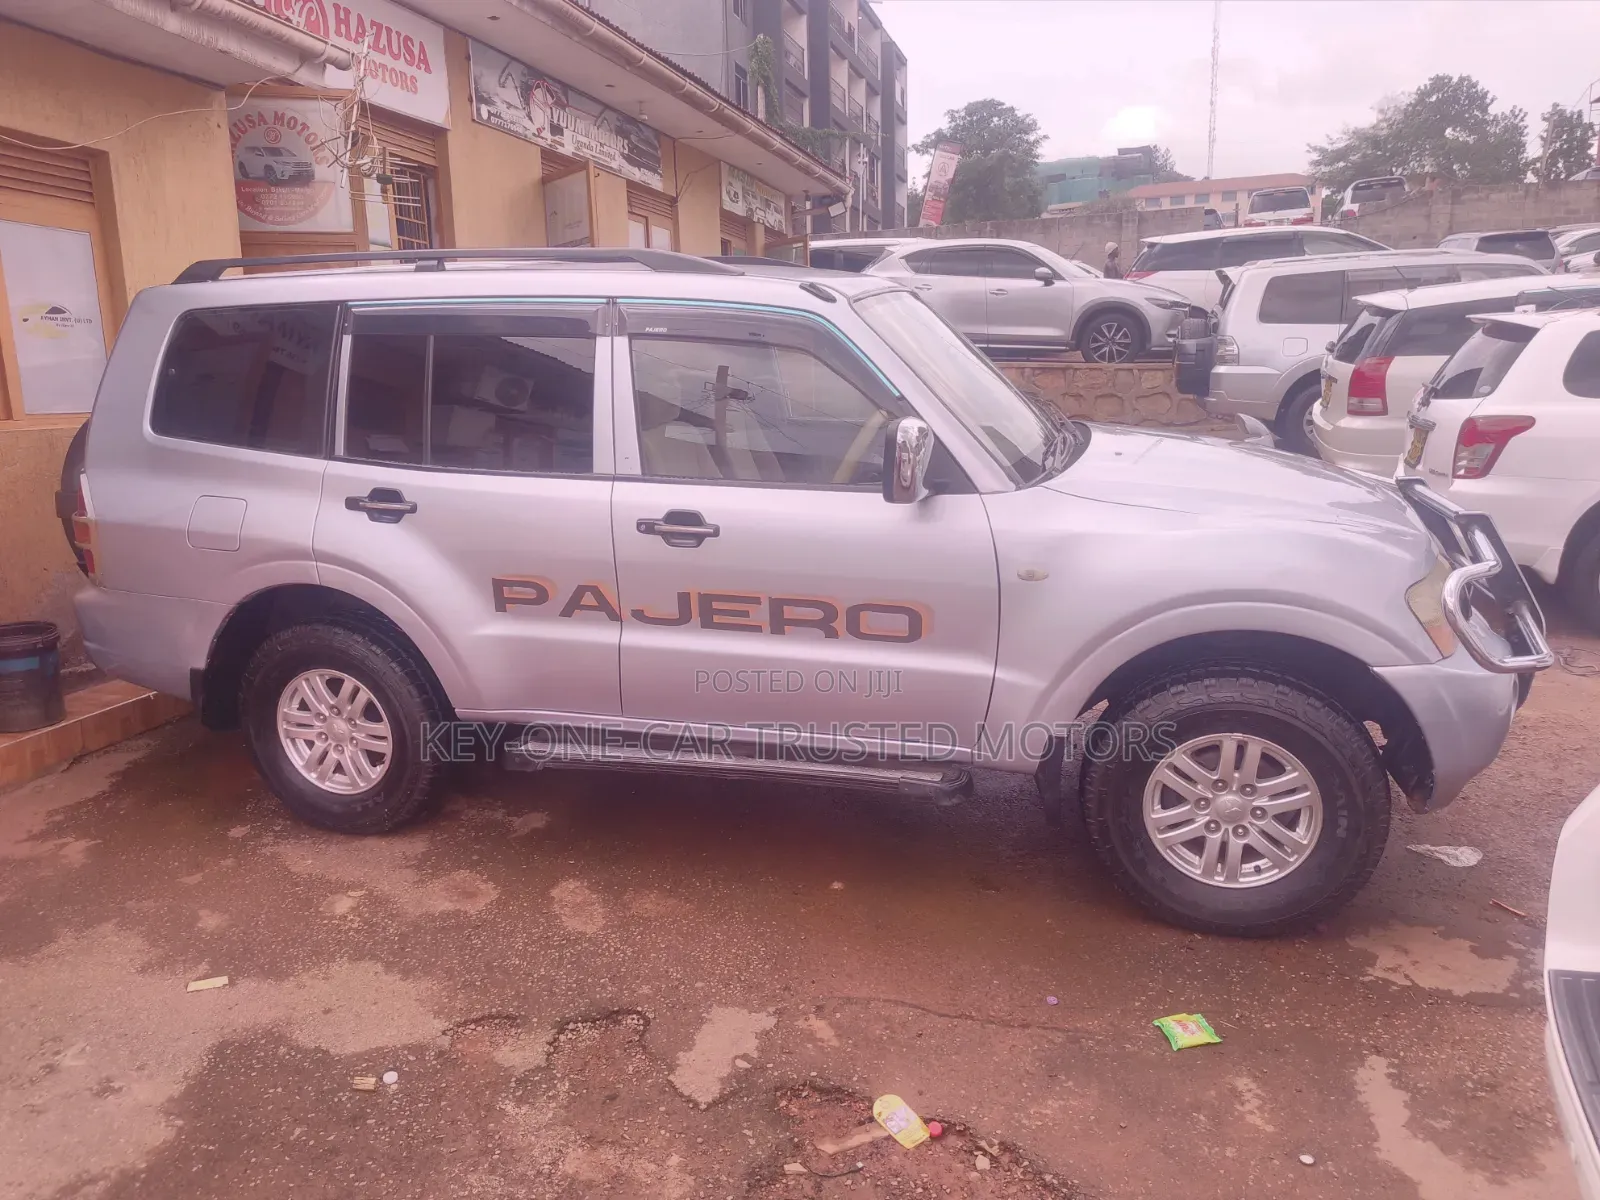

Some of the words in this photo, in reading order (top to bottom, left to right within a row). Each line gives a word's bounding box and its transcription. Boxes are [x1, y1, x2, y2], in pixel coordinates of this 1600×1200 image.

[332, 2, 433, 75] HAZUSA
[571, 134, 594, 151] Uganda
[491, 574, 933, 643] PAJERO
